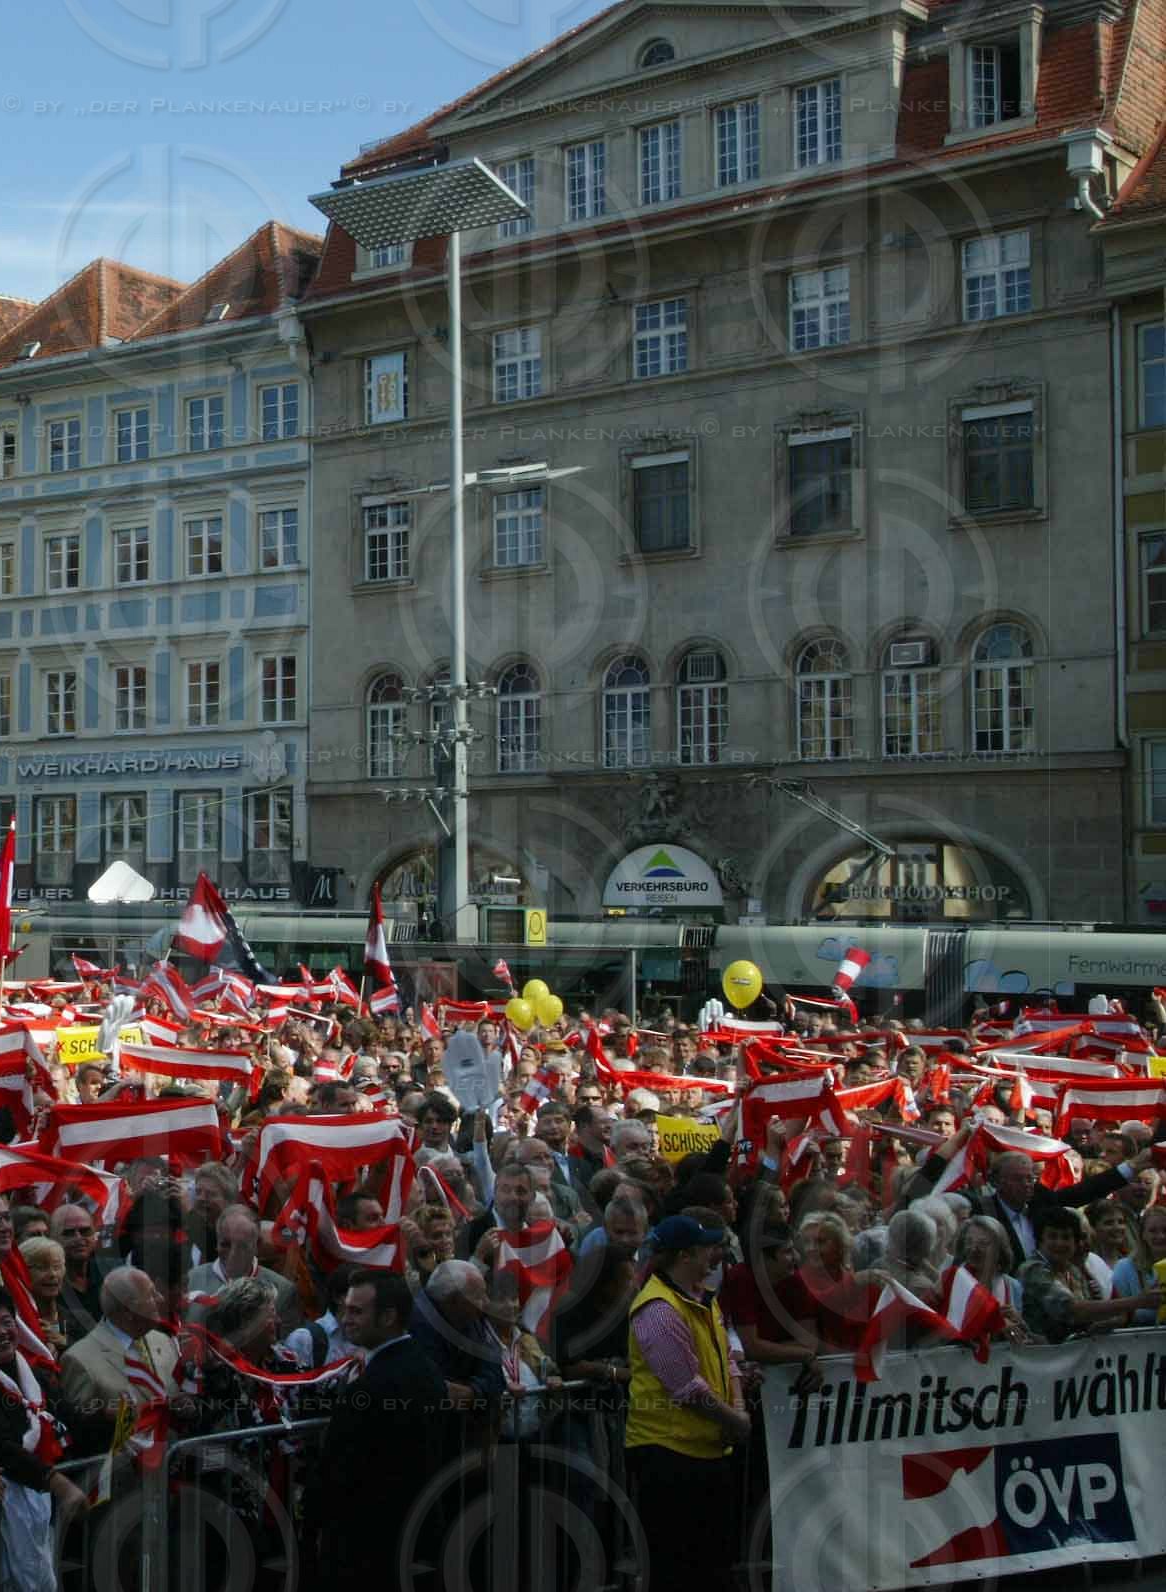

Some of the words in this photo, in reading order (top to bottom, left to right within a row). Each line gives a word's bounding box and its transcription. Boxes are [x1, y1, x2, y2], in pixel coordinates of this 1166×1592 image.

[616, 880, 709, 892] VERKEHRSBÜRO
[788, 1366, 1028, 1449] Tillmitsch
[1003, 1456, 1117, 1529] ÖVP
